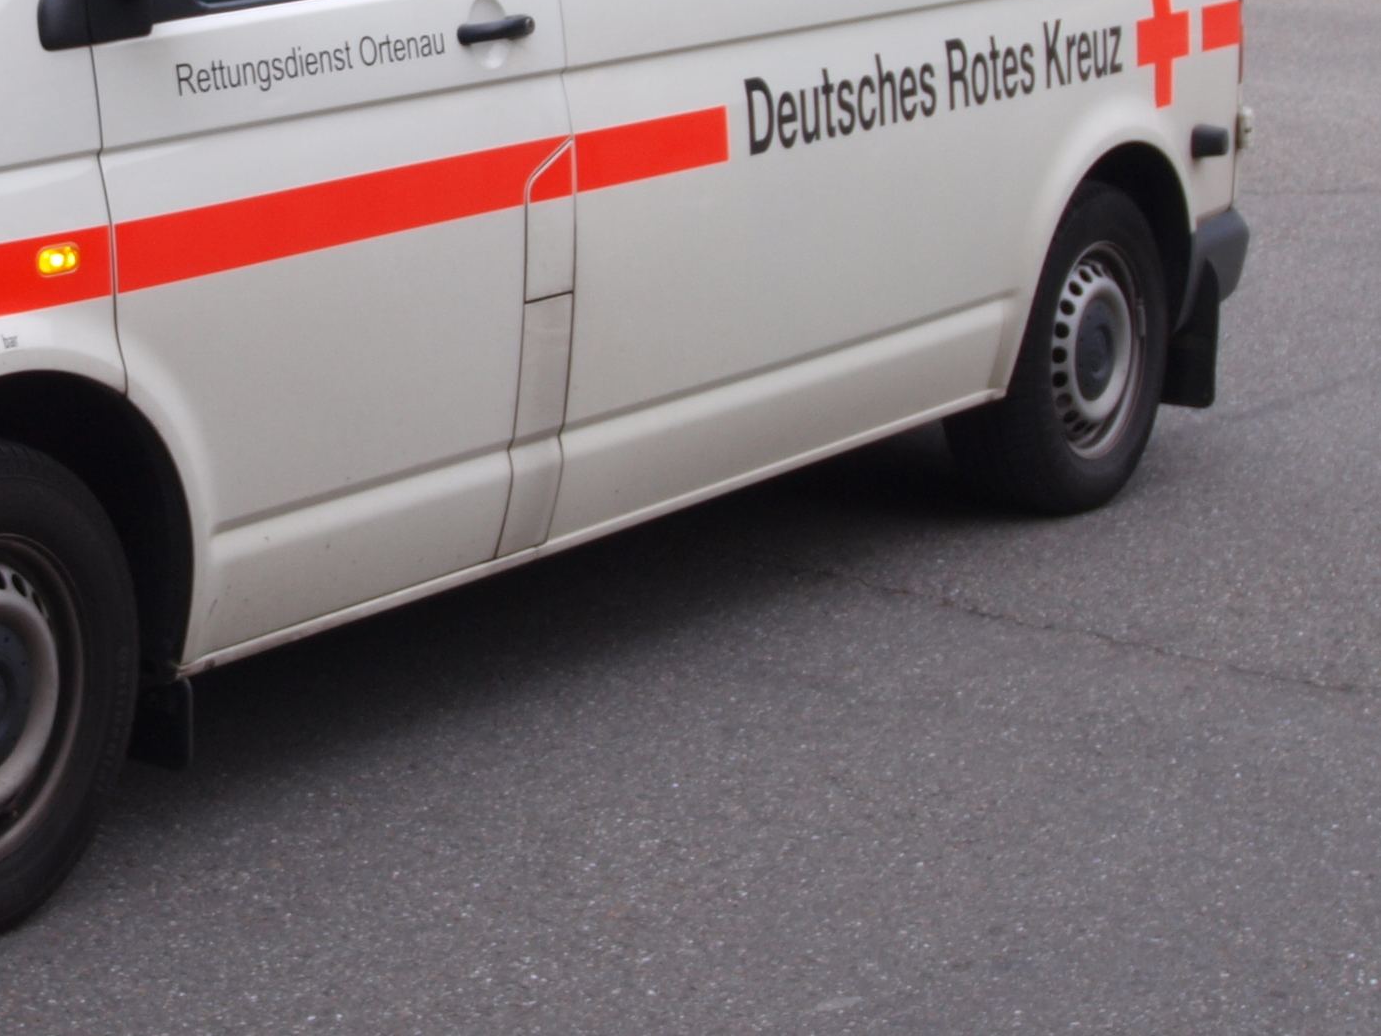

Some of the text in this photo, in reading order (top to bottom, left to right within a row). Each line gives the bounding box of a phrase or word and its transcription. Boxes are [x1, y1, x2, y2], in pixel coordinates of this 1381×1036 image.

[174, 33, 445, 96] Rettungsdienst Ortenau
[744, 18, 1122, 156] Deutsches Rotes Kreuz
